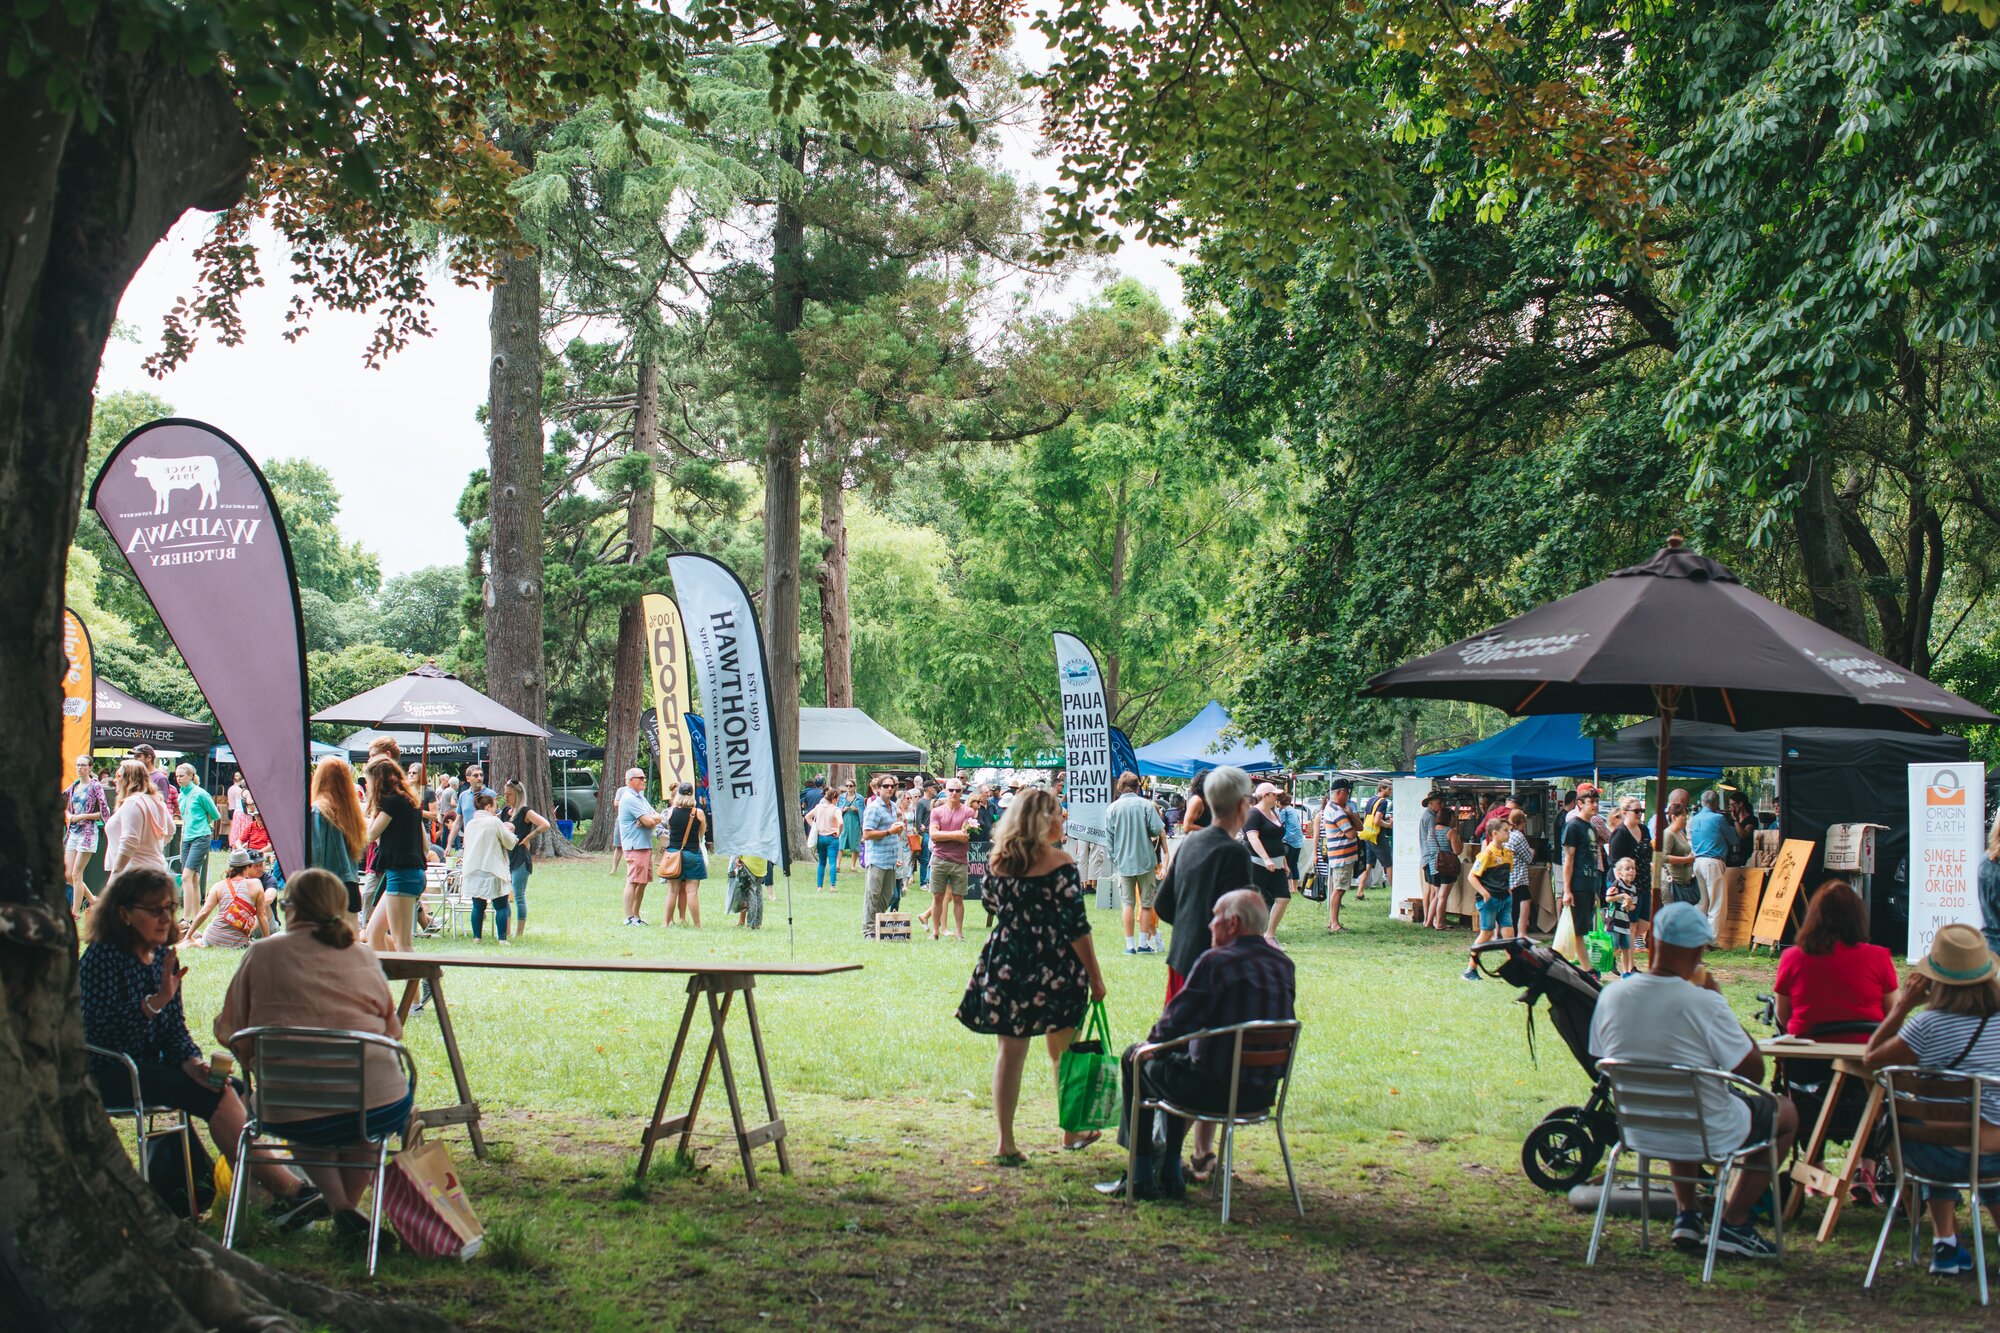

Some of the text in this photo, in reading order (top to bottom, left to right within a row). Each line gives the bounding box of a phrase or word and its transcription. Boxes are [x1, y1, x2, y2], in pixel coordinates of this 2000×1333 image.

[710, 610, 755, 799] HAWTHORNE
[747, 672, 761, 732] EST. 1999
[1063, 691, 1103, 710] PAUA
[699, 627, 717, 685] SPECIALTY
[714, 735, 725, 791] ROASTERS
[1065, 713, 1104, 730] KINA
[151, 729, 174, 742] HERE
[1066, 732, 1106, 749] WHITE
[400, 745, 468, 755] BLAC PUDDING
[1070, 770, 1107, 786] RAW
[1069, 787, 1108, 803] FISH
[1926, 807, 1966, 819] ORIGIN
[1069, 823, 1086, 833] FRESH
[1926, 820, 1966, 833] EARTH
[1924, 849, 1967, 863] SINGLE
[1929, 865, 1963, 878] FARM
[1925, 879, 1967, 894] ORIGIN
[1939, 896, 1965, 908] 2010
